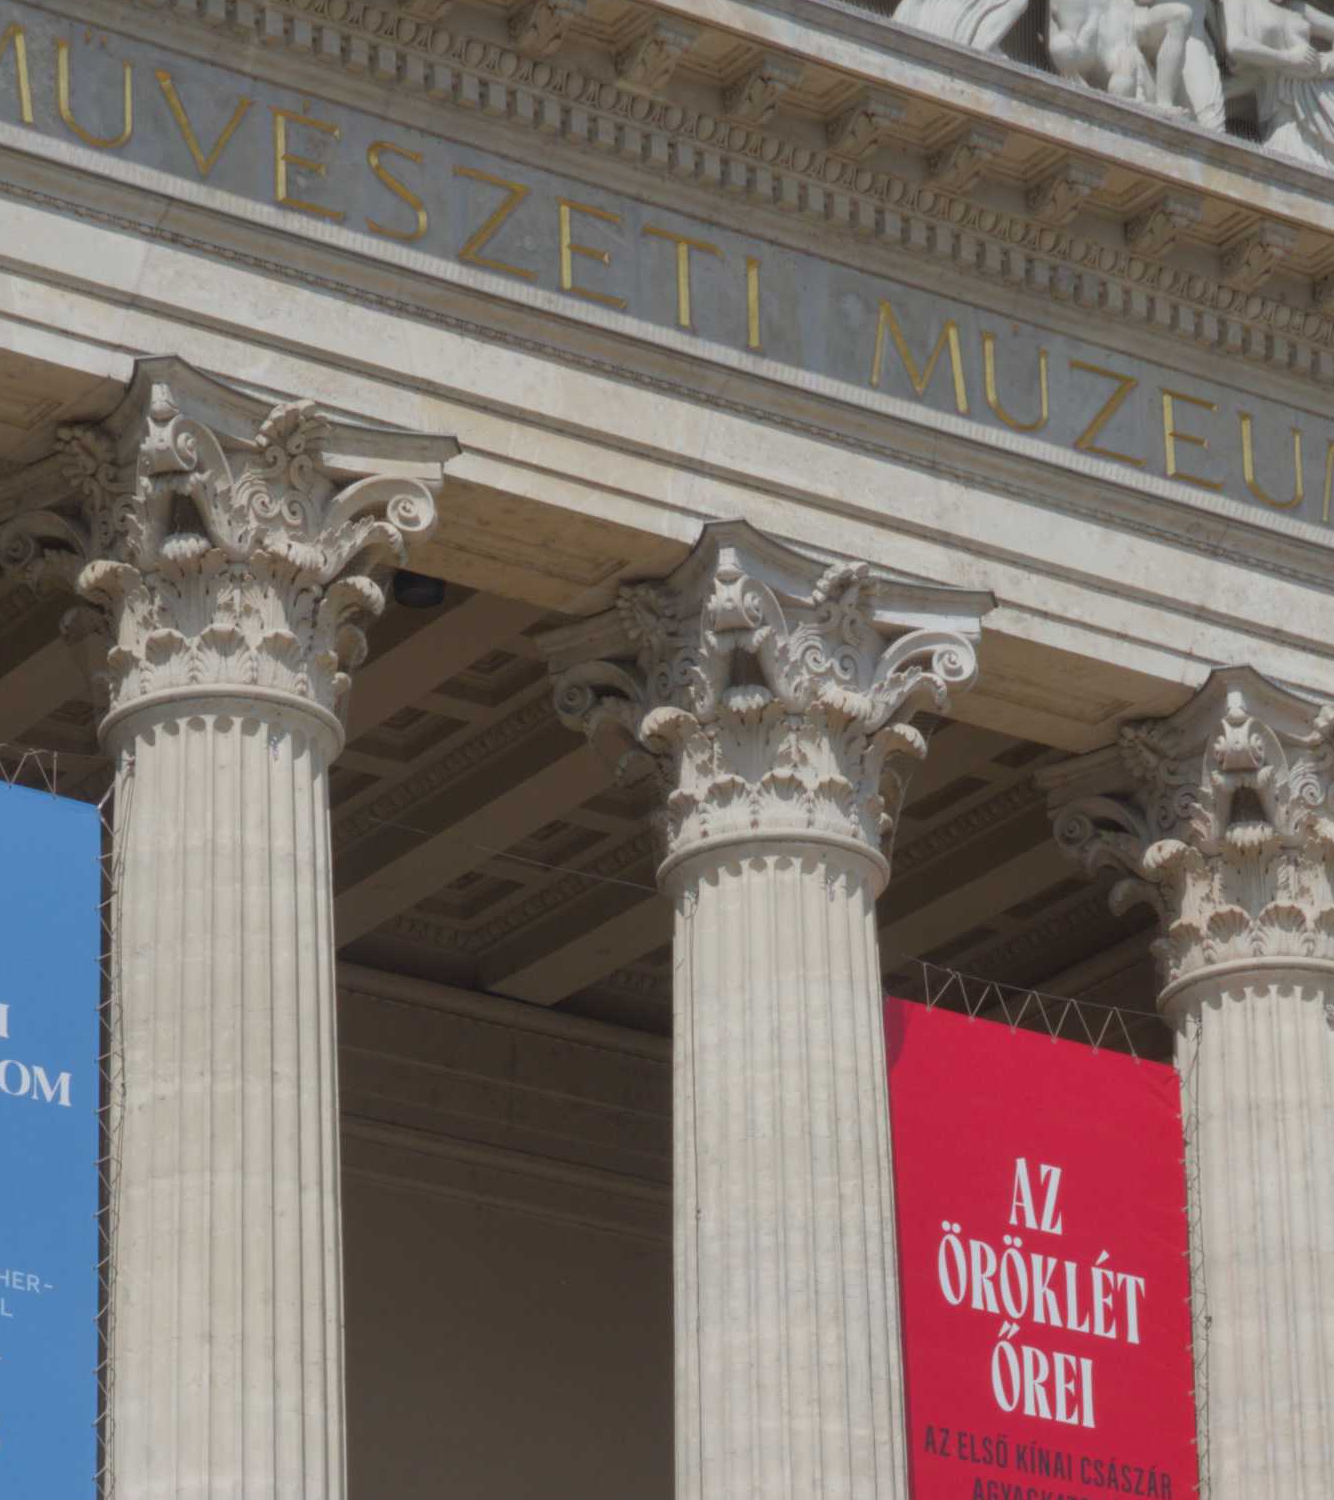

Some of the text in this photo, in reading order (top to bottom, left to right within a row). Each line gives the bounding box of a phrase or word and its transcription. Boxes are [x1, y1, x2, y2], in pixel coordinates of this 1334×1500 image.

[1009, 1157, 1063, 1235] AZ
[938, 1220, 1145, 1345] ÖRÖKLÉT
[991, 1322, 1095, 1428] ŐREI
[924, 1425, 1172, 1500] AZ ELSŐ KÍNAI CSÁSZÁR
